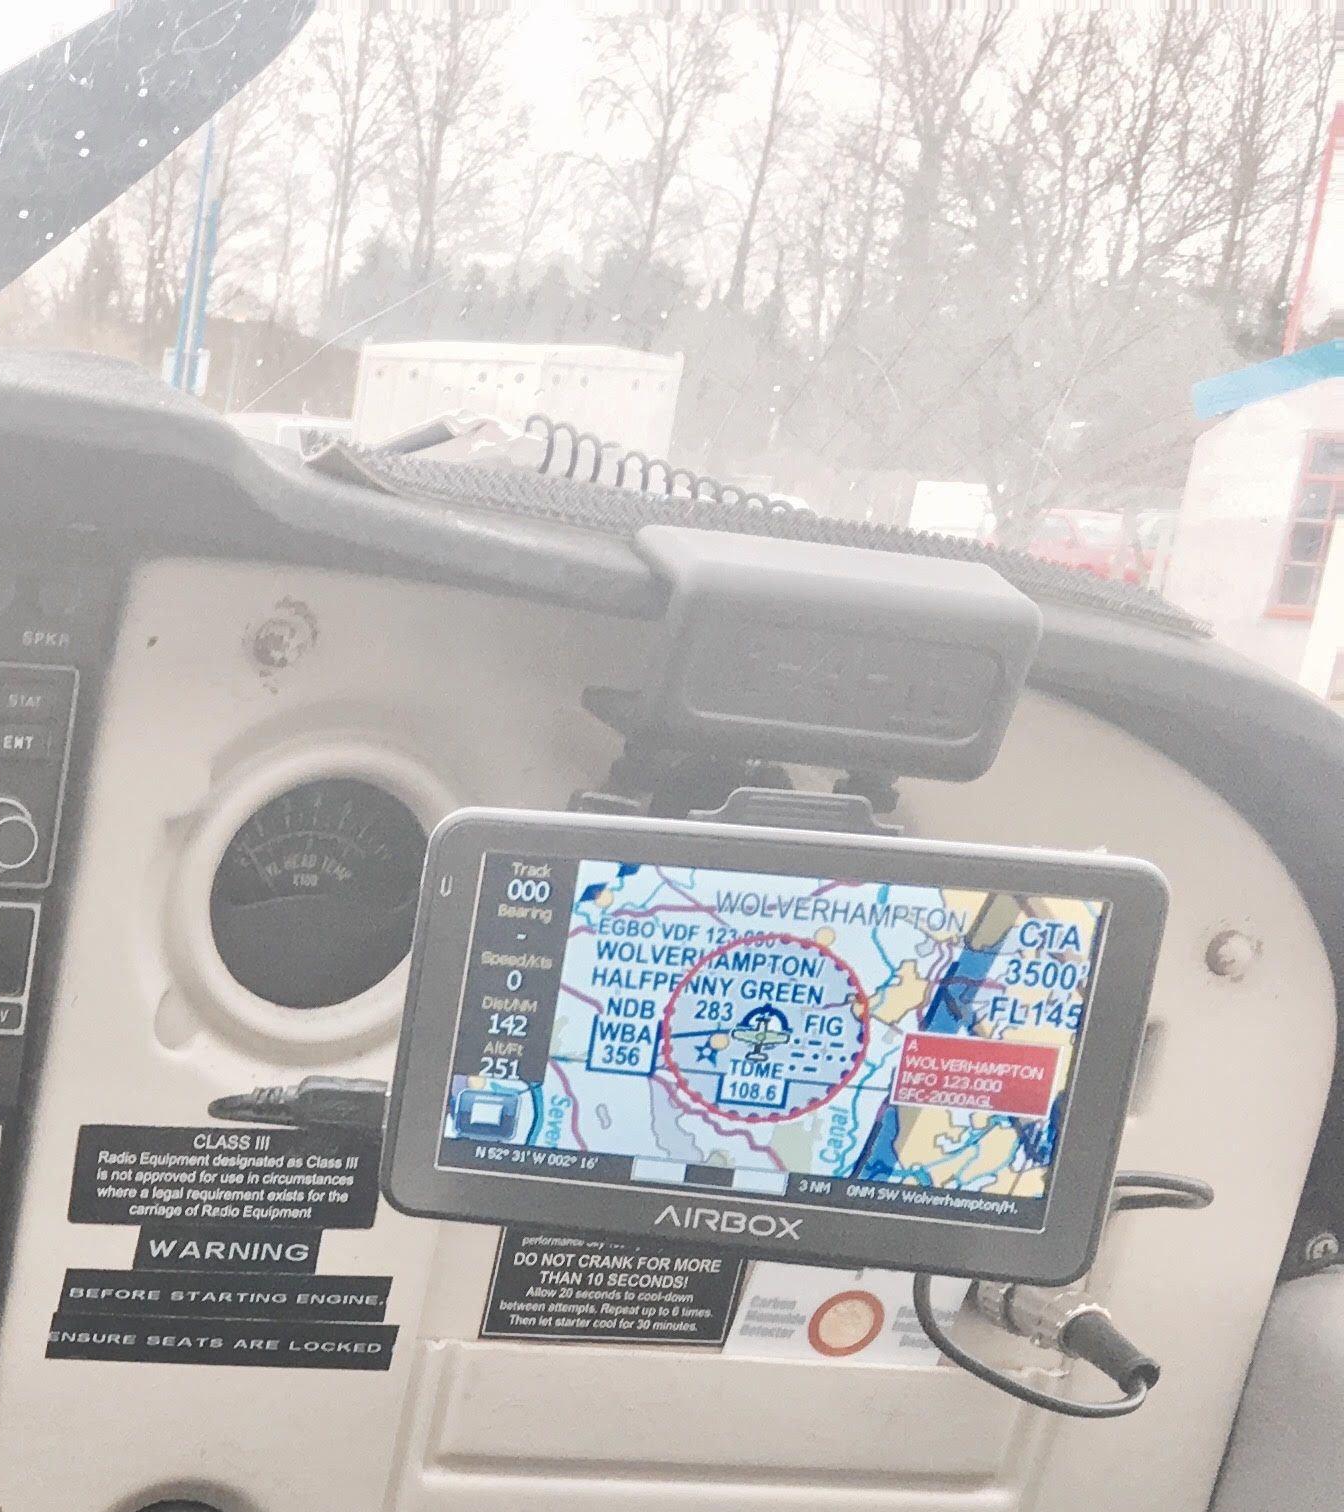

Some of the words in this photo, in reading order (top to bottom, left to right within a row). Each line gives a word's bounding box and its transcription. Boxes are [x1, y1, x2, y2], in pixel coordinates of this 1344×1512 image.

[3, 734, 35, 751] ENT
[512, 862, 551, 878] Track
[508, 879, 550, 902] 000
[716, 890, 967, 933] WOLVERHAMPTON
[598, 918, 655, 937] EGBO
[662, 923, 700, 941] VDF
[1020, 921, 1081, 951] CTA
[592, 968, 738, 997] HALFPENNY
[740, 979, 824, 1006] GREEN
[607, 999, 654, 1018] NDB
[695, 1001, 733, 1021] 283
[989, 997, 1082, 1030] FL145
[489, 1014, 527, 1036] 142
[599, 1022, 652, 1044] WBA
[804, 1015, 843, 1035] FIG
[602, 1045, 639, 1066] 356
[479, 1057, 520, 1080] 251
[729, 1059, 782, 1077] TDME
[905, 1057, 1044, 1080] WOLVERHAMPTON
[729, 1082, 776, 1100] 108.6
[902, 1073, 937, 1088] INFO
[943, 1076, 1002, 1093] 123.000
[194, 1134, 251, 1149] CLASS
[255, 1136, 270, 1150] III
[98, 1151, 137, 1165] Radio
[139, 1152, 210, 1168] Equipment
[213, 1154, 283, 1169] designated
[306, 1155, 342, 1169] Class
[110, 1170, 132, 1181] not
[135, 1171, 196, 1186] approved
[199, 1171, 217, 1183] for
[221, 1174, 243, 1184] use
[263, 1173, 354, 1186] circumstances
[187, 1188, 264, 1202] requirement
[129, 1205, 182, 1218] carriage
[201, 1205, 239, 1218] Radio
[243, 1206, 312, 1220] Equipment
[654, 1205, 803, 1240] AIRBOX
[149, 1240, 309, 1261] WARNING
[514, 1253, 536, 1265] DO
[541, 1253, 575, 1267] NOT
[579, 1254, 633, 1270] CRANK
[637, 1257, 671, 1270] FOR
[675, 1257, 721, 1273] MORE
[540, 1271, 583, 1285] THAN
[586, 1273, 604, 1285] 10
[607, 1274, 688, 1288] SECONDS!
[69, 1288, 160, 1300] BEFORE
[171, 1291, 287, 1303] STARTING
[296, 1294, 385, 1305] ENGINE.
[49, 1332, 136, 1345] ENSURE
[147, 1336, 223, 1348] SEATS
[234, 1339, 279, 1350] ARE
[289, 1340, 382, 1353] LOCKED
